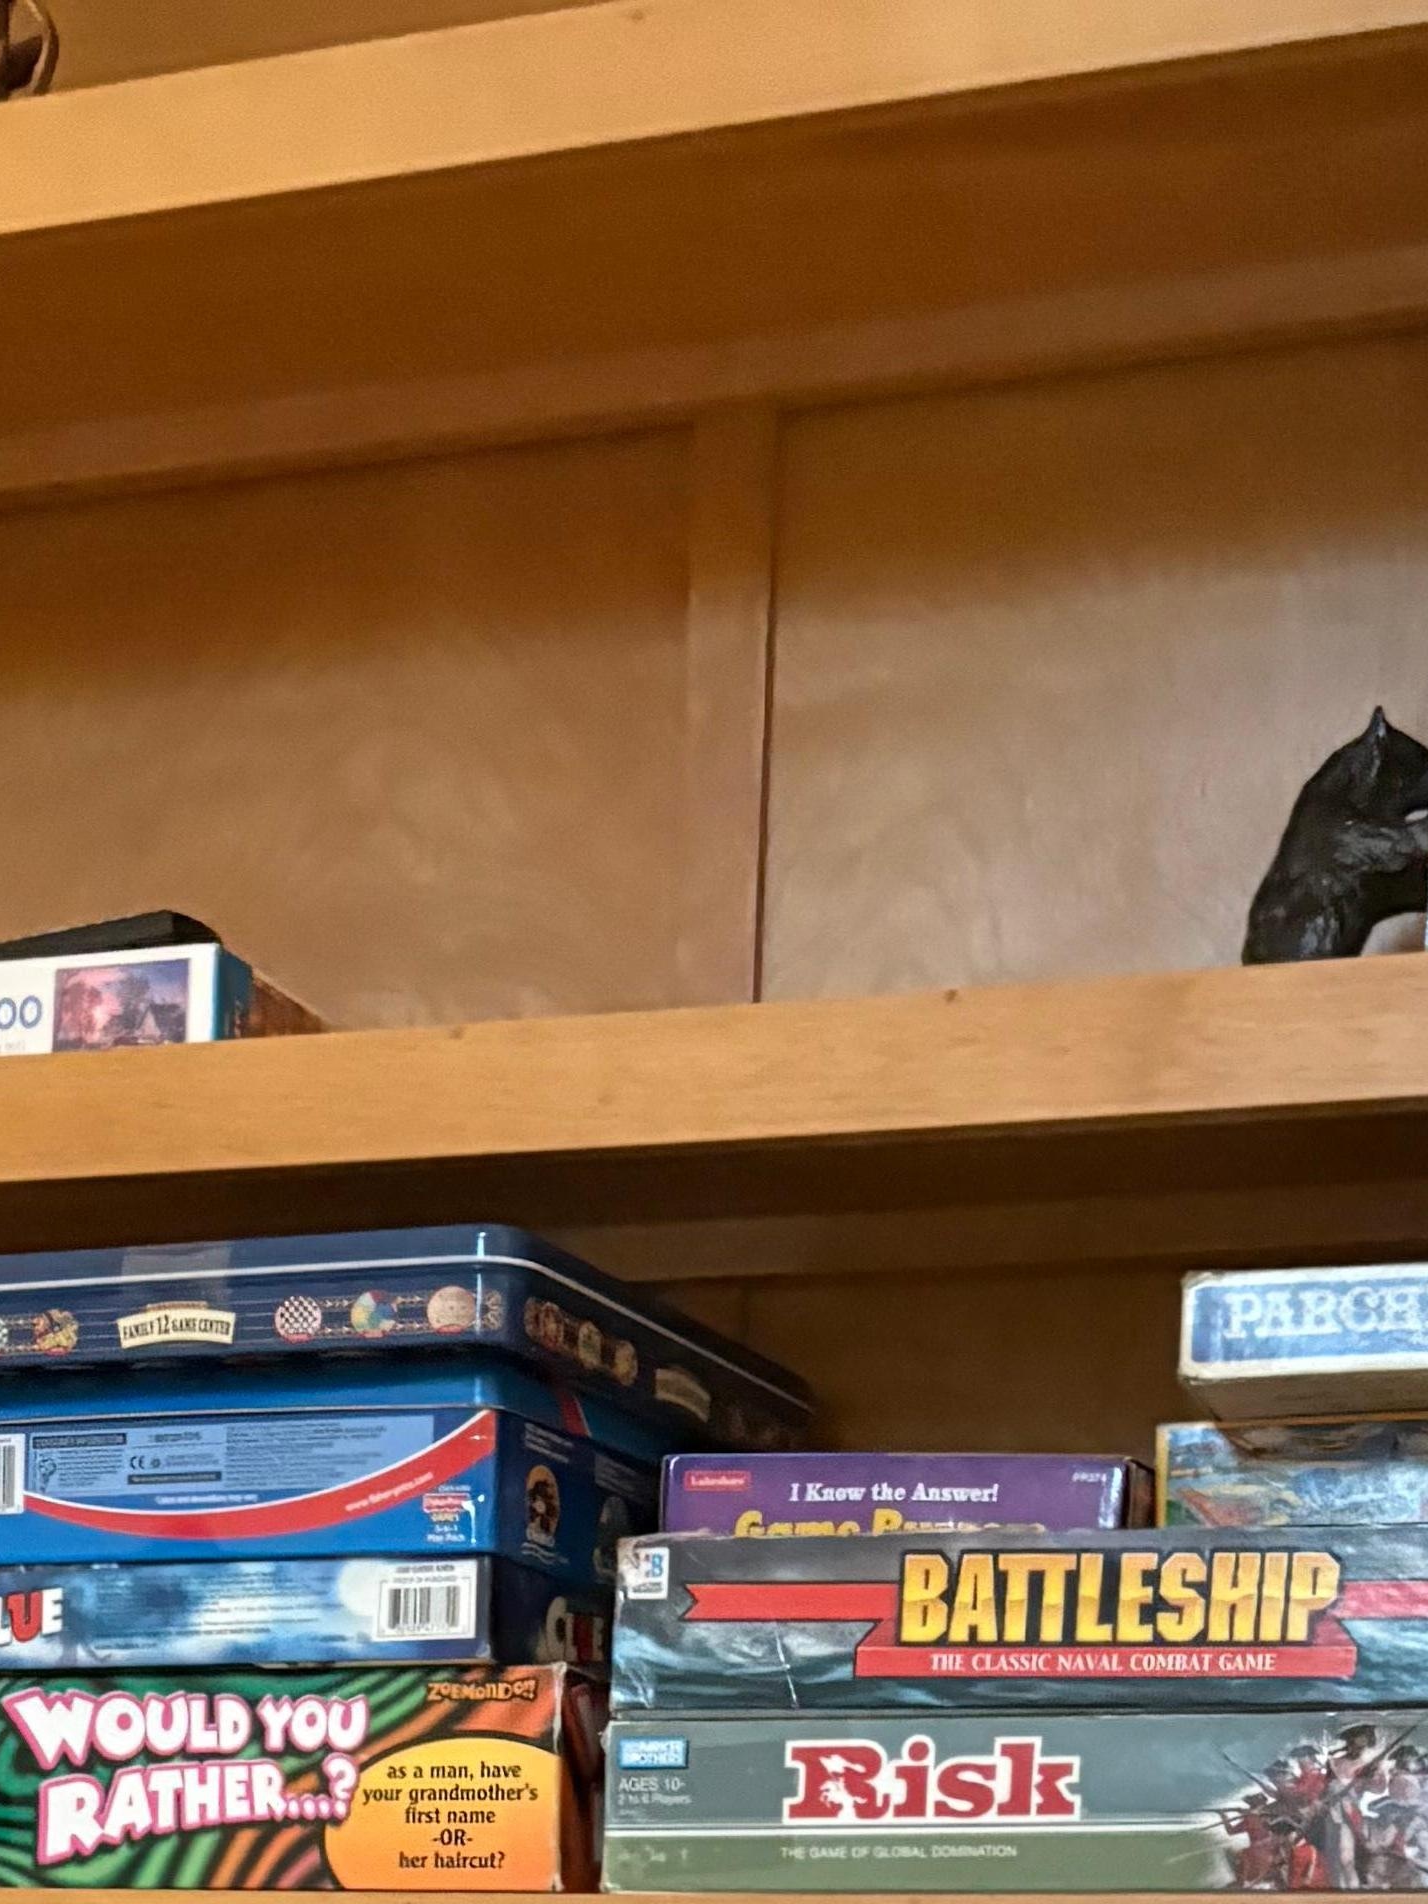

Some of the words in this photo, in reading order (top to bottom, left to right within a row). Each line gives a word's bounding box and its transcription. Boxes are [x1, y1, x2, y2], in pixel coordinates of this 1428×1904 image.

[122, 1323, 154, 1339] FAMILY
[172, 1320, 196, 1333] GAME
[197, 1318, 231, 1335] CENTER
[790, 1483, 800, 1501] I
[804, 1483, 868, 1502] Know
[872, 1483, 906, 1501] the
[911, 1483, 999, 1502] Answer!
[899, 1551, 1341, 1644] BATTLESHIP
[931, 1654, 966, 1671] THE
[972, 1653, 1051, 1671] CLASSIC
[1057, 1653, 1123, 1671] NAVAL
[1129, 1652, 1212, 1671] COMBAT
[1218, 1652, 1277, 1671] GAME
[4, 1689, 250, 1770] WOULD
[255, 1693, 368, 1754] YOU
[388, 1765, 409, 1780] as
[414, 1766, 425, 1780] a
[430, 1765, 474, 1782] man,
[480, 1762, 522, 1779] have
[786, 1737, 1078, 1821] Risk
[363, 1788, 403, 1806] your
[408, 1783, 539, 1807] grandmother's
[618, 1778, 659, 1792] AGES
[405, 1806, 441, 1825] first
[446, 1810, 496, 1825] name
[432, 1829, 474, 1847] -OR-
[398, 1851, 428, 1869] her
[433, 1850, 506, 1870] haircut?
[780, 1846, 806, 1859] THE
[810, 1846, 848, 1860] GAME
[852, 1846, 869, 1859] OF
[873, 1846, 928, 1859] GLOBAL
[930, 1845, 1018, 1859] DOMINATION
